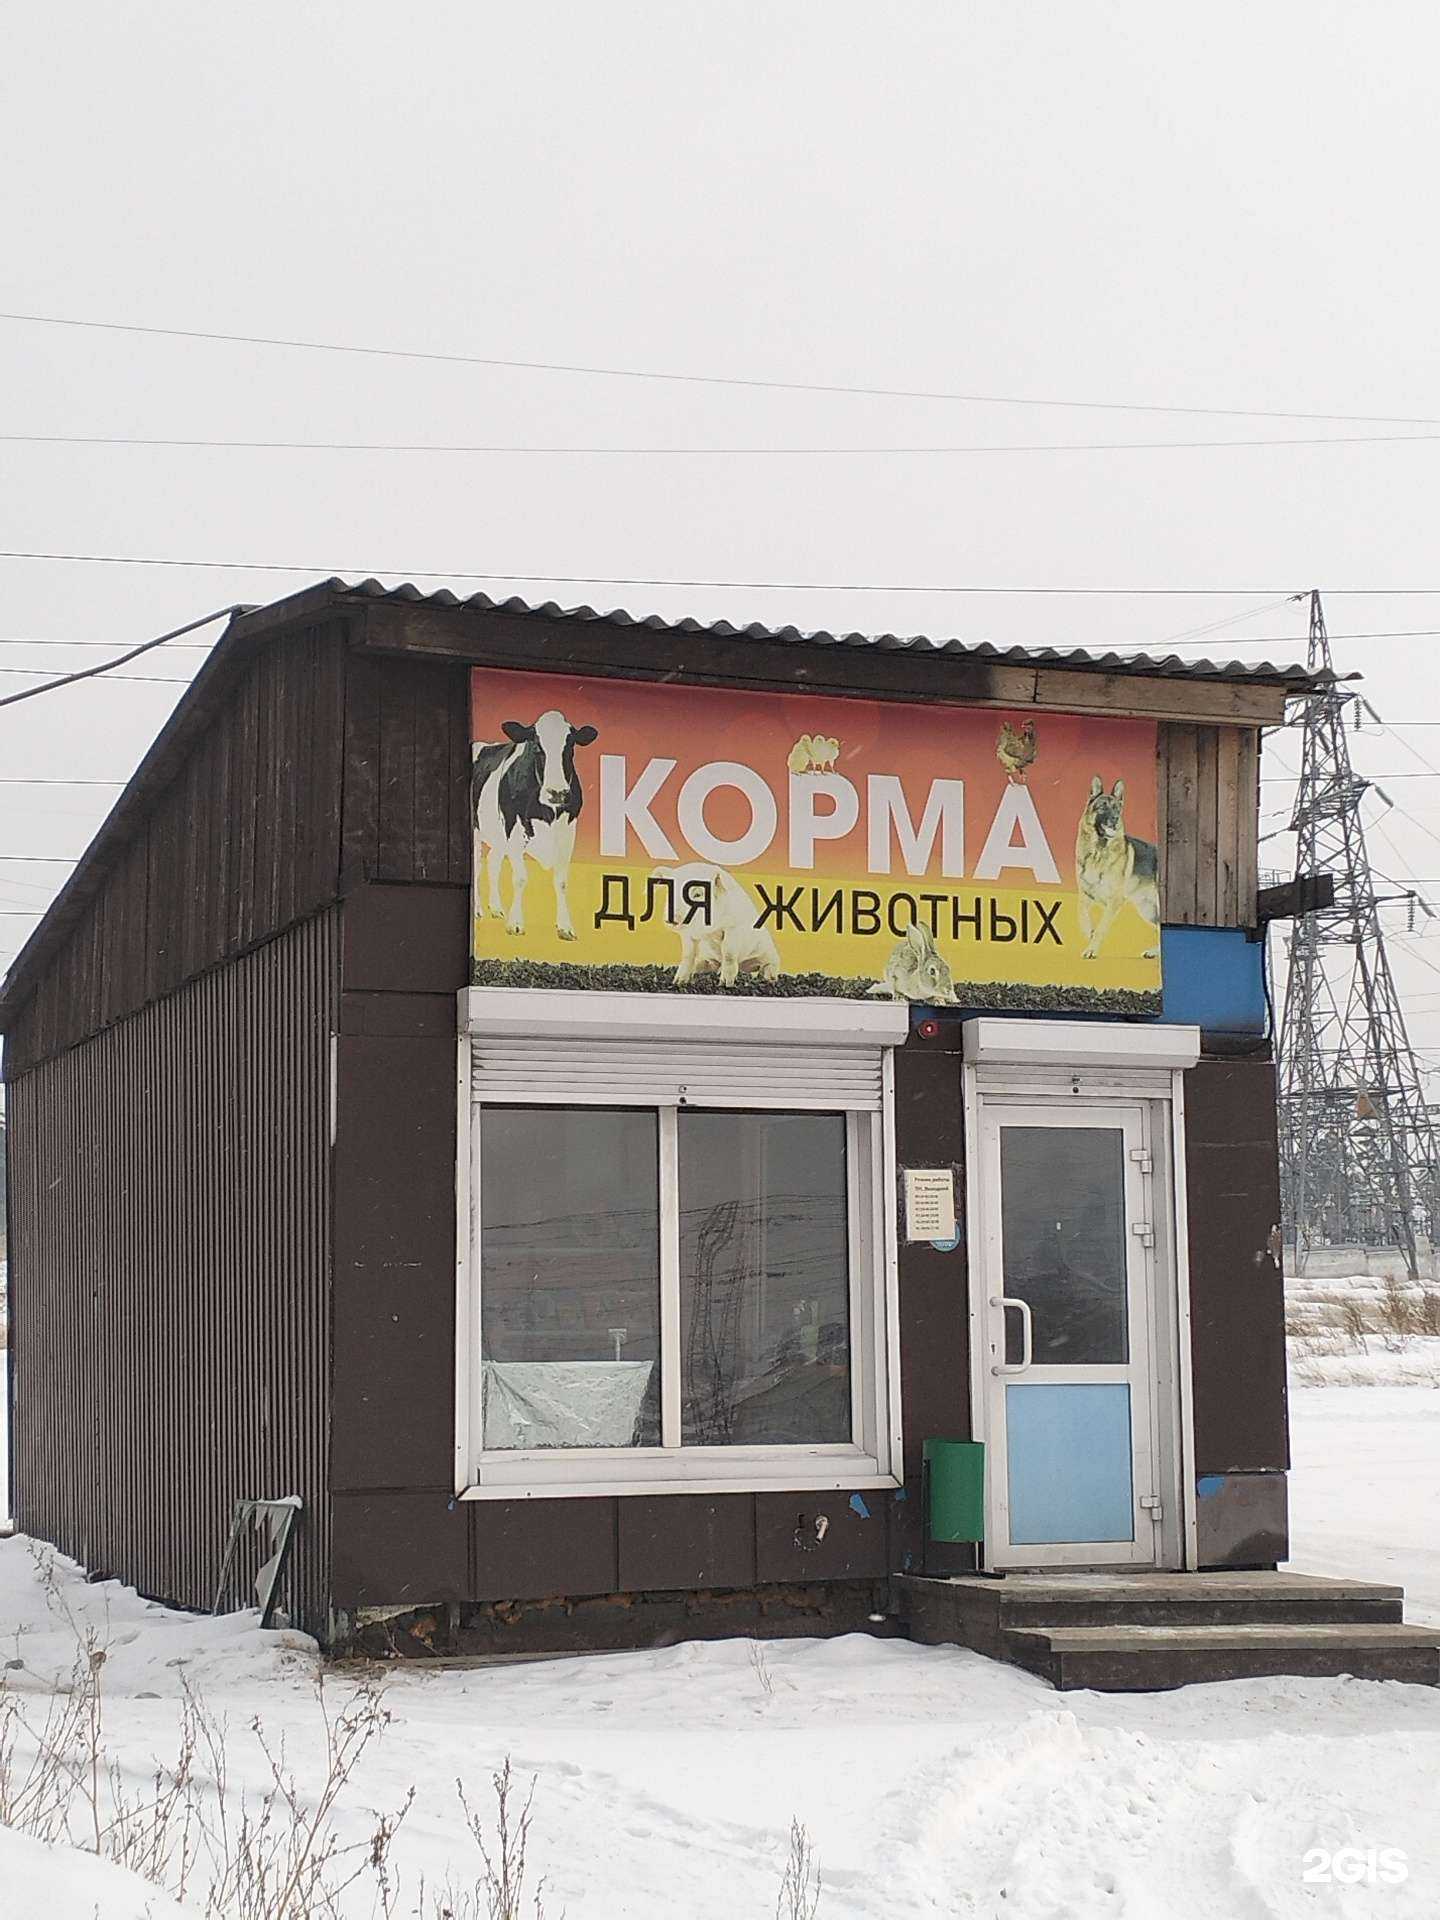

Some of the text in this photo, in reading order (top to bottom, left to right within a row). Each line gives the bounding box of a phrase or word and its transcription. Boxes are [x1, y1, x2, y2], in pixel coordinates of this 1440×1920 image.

[598, 754, 1062, 883] КОРМА
[594, 874, 1063, 945] ДЛЯ ЖИВОТНЫХ
